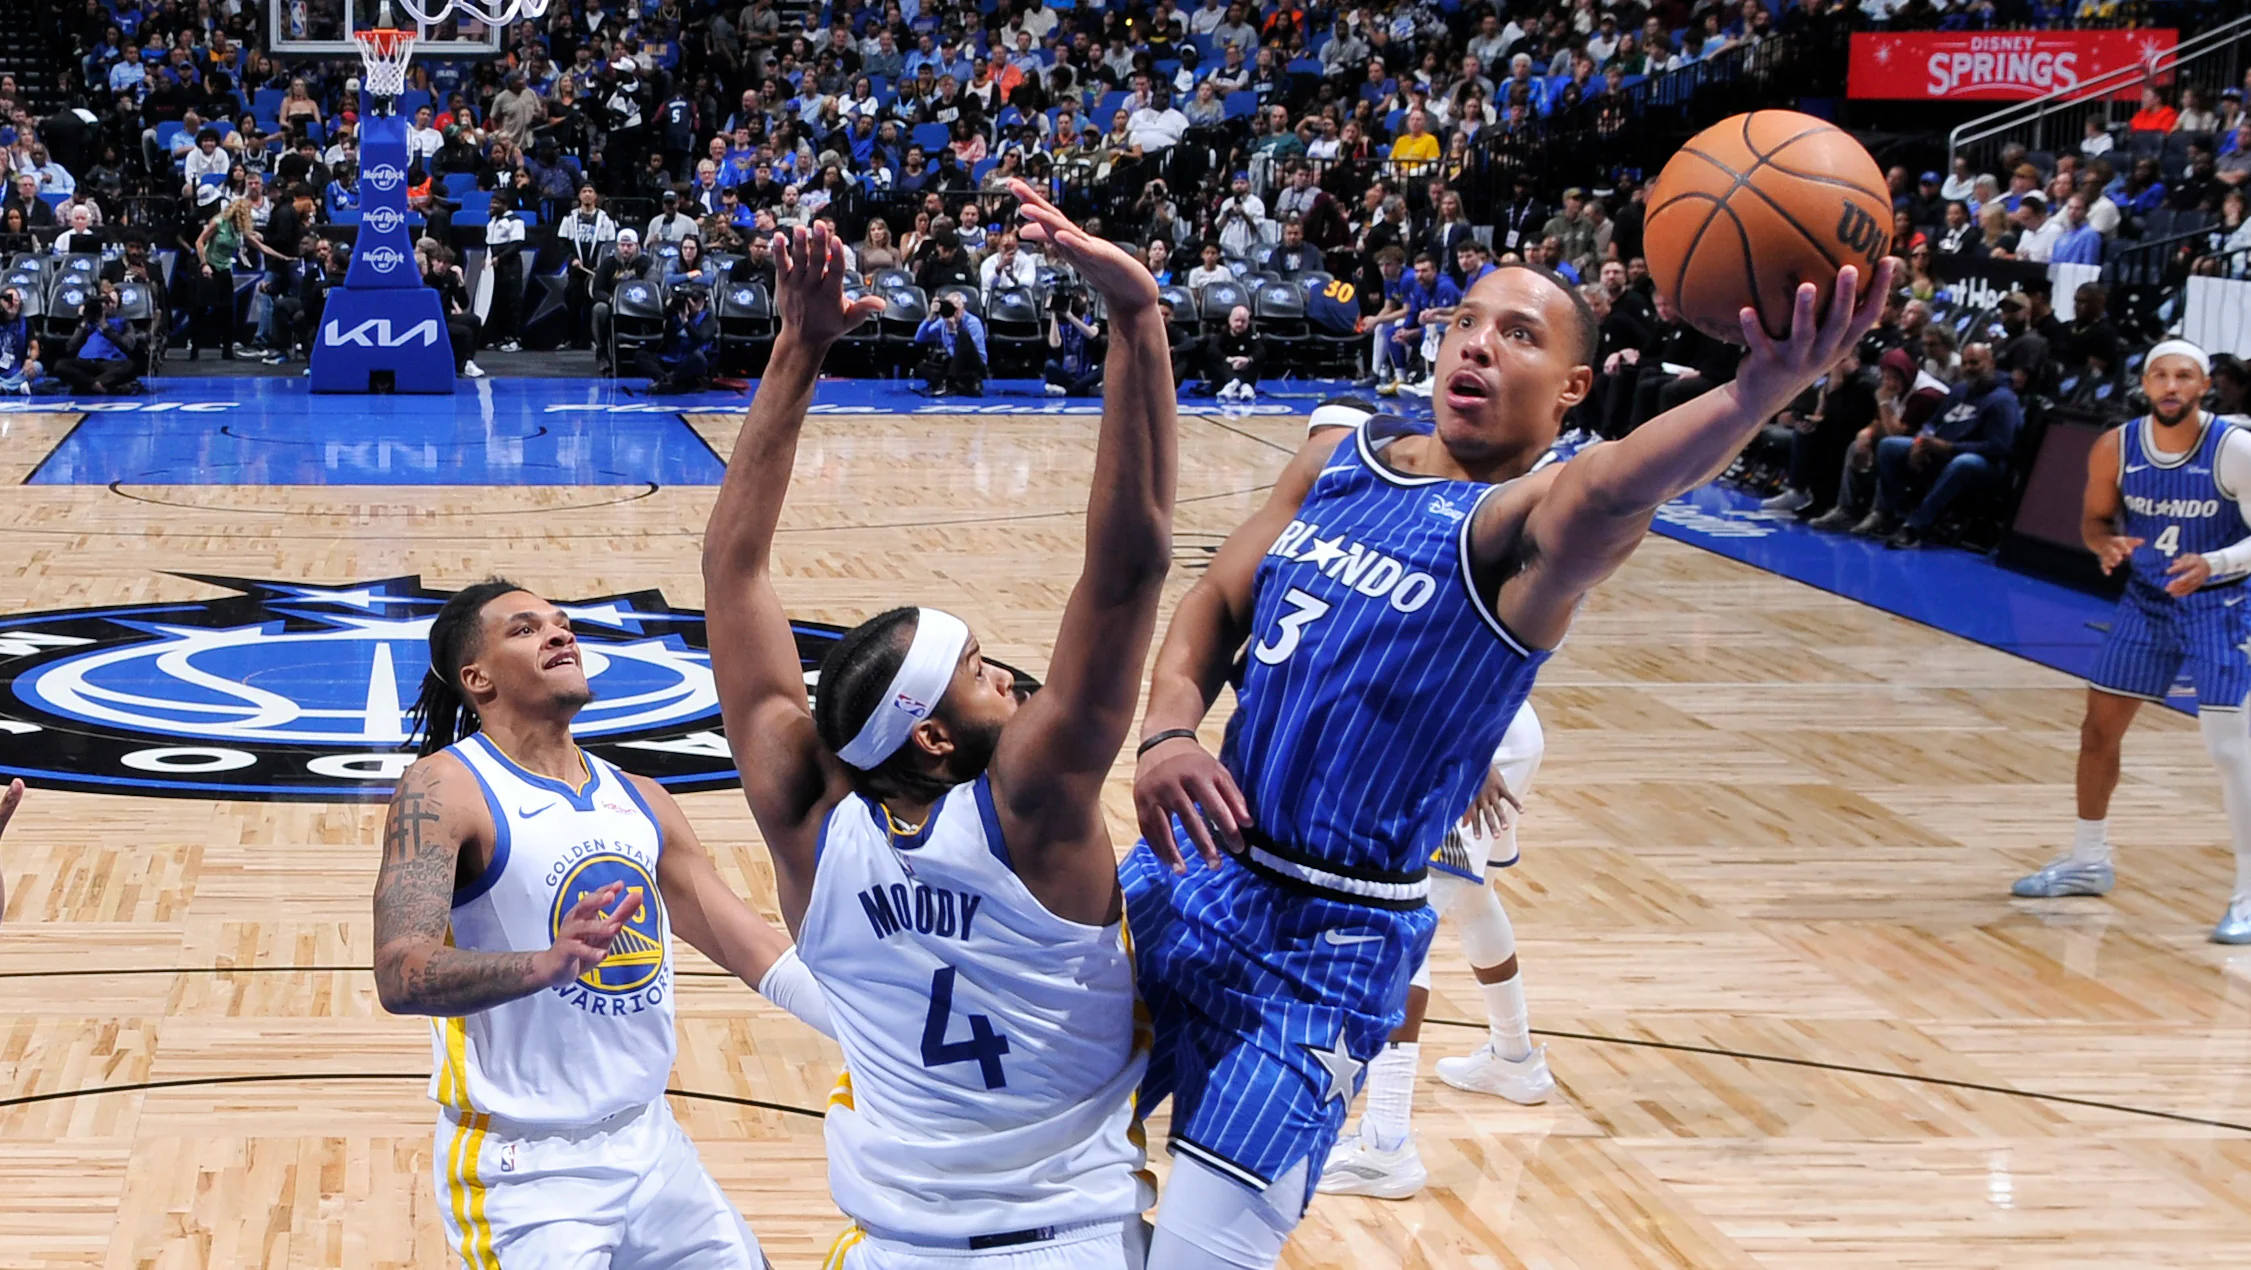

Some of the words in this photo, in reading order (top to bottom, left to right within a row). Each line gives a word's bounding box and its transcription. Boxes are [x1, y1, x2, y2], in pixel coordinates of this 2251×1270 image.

[1970, 36, 2035, 51] DISNEY
[1927, 51, 2078, 96] SPRINGS
[362, 169, 384, 180] Hard
[384, 169, 405, 181] Rock
[362, 212, 384, 222] Hard
[384, 212, 405, 224] Rock
[1837, 199, 1890, 265] Wil
[362, 251, 384, 261] Hard
[384, 251, 405, 264] Rock
[1323, 279, 1355, 303] 30
[325, 318, 438, 347] KIA
[2123, 494, 2219, 518] ORLANDO
[2154, 525, 2181, 557] 4
[1266, 519, 1437, 613] RLANDO
[1254, 587, 1331, 665] 3
[545, 838, 606, 887] GOLDEN
[857, 883, 981, 942] MOODY
[920, 965, 1010, 1090] 4
